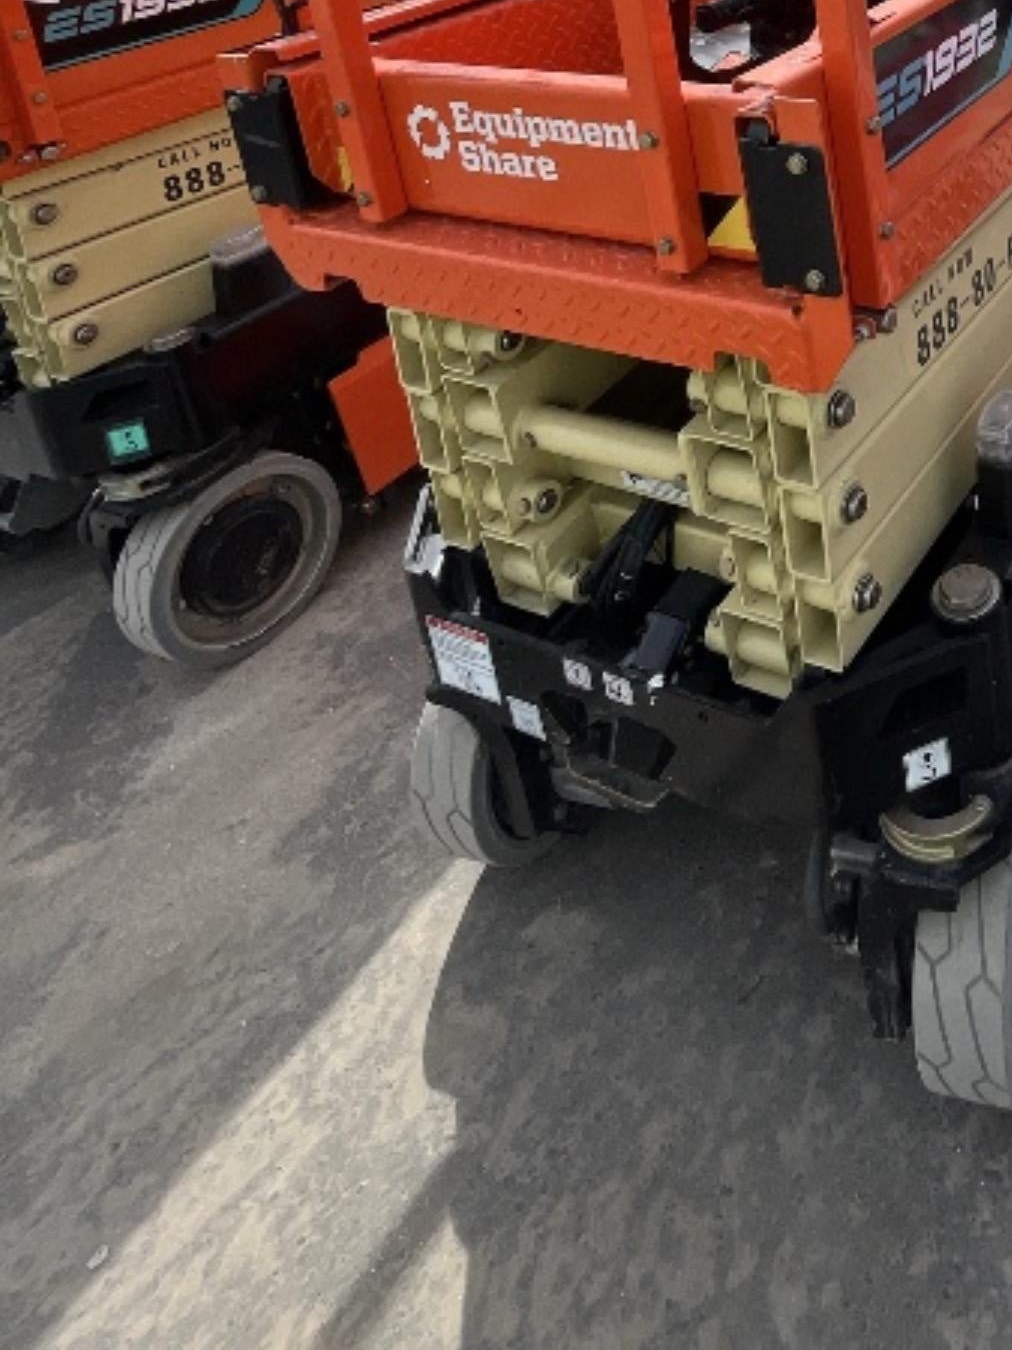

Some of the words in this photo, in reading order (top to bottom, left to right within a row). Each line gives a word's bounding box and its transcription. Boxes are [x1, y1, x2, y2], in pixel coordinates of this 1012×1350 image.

[876, 8, 998, 127] ES1932
[449, 100, 640, 151] Equipment
[457, 140, 560, 182] Share
